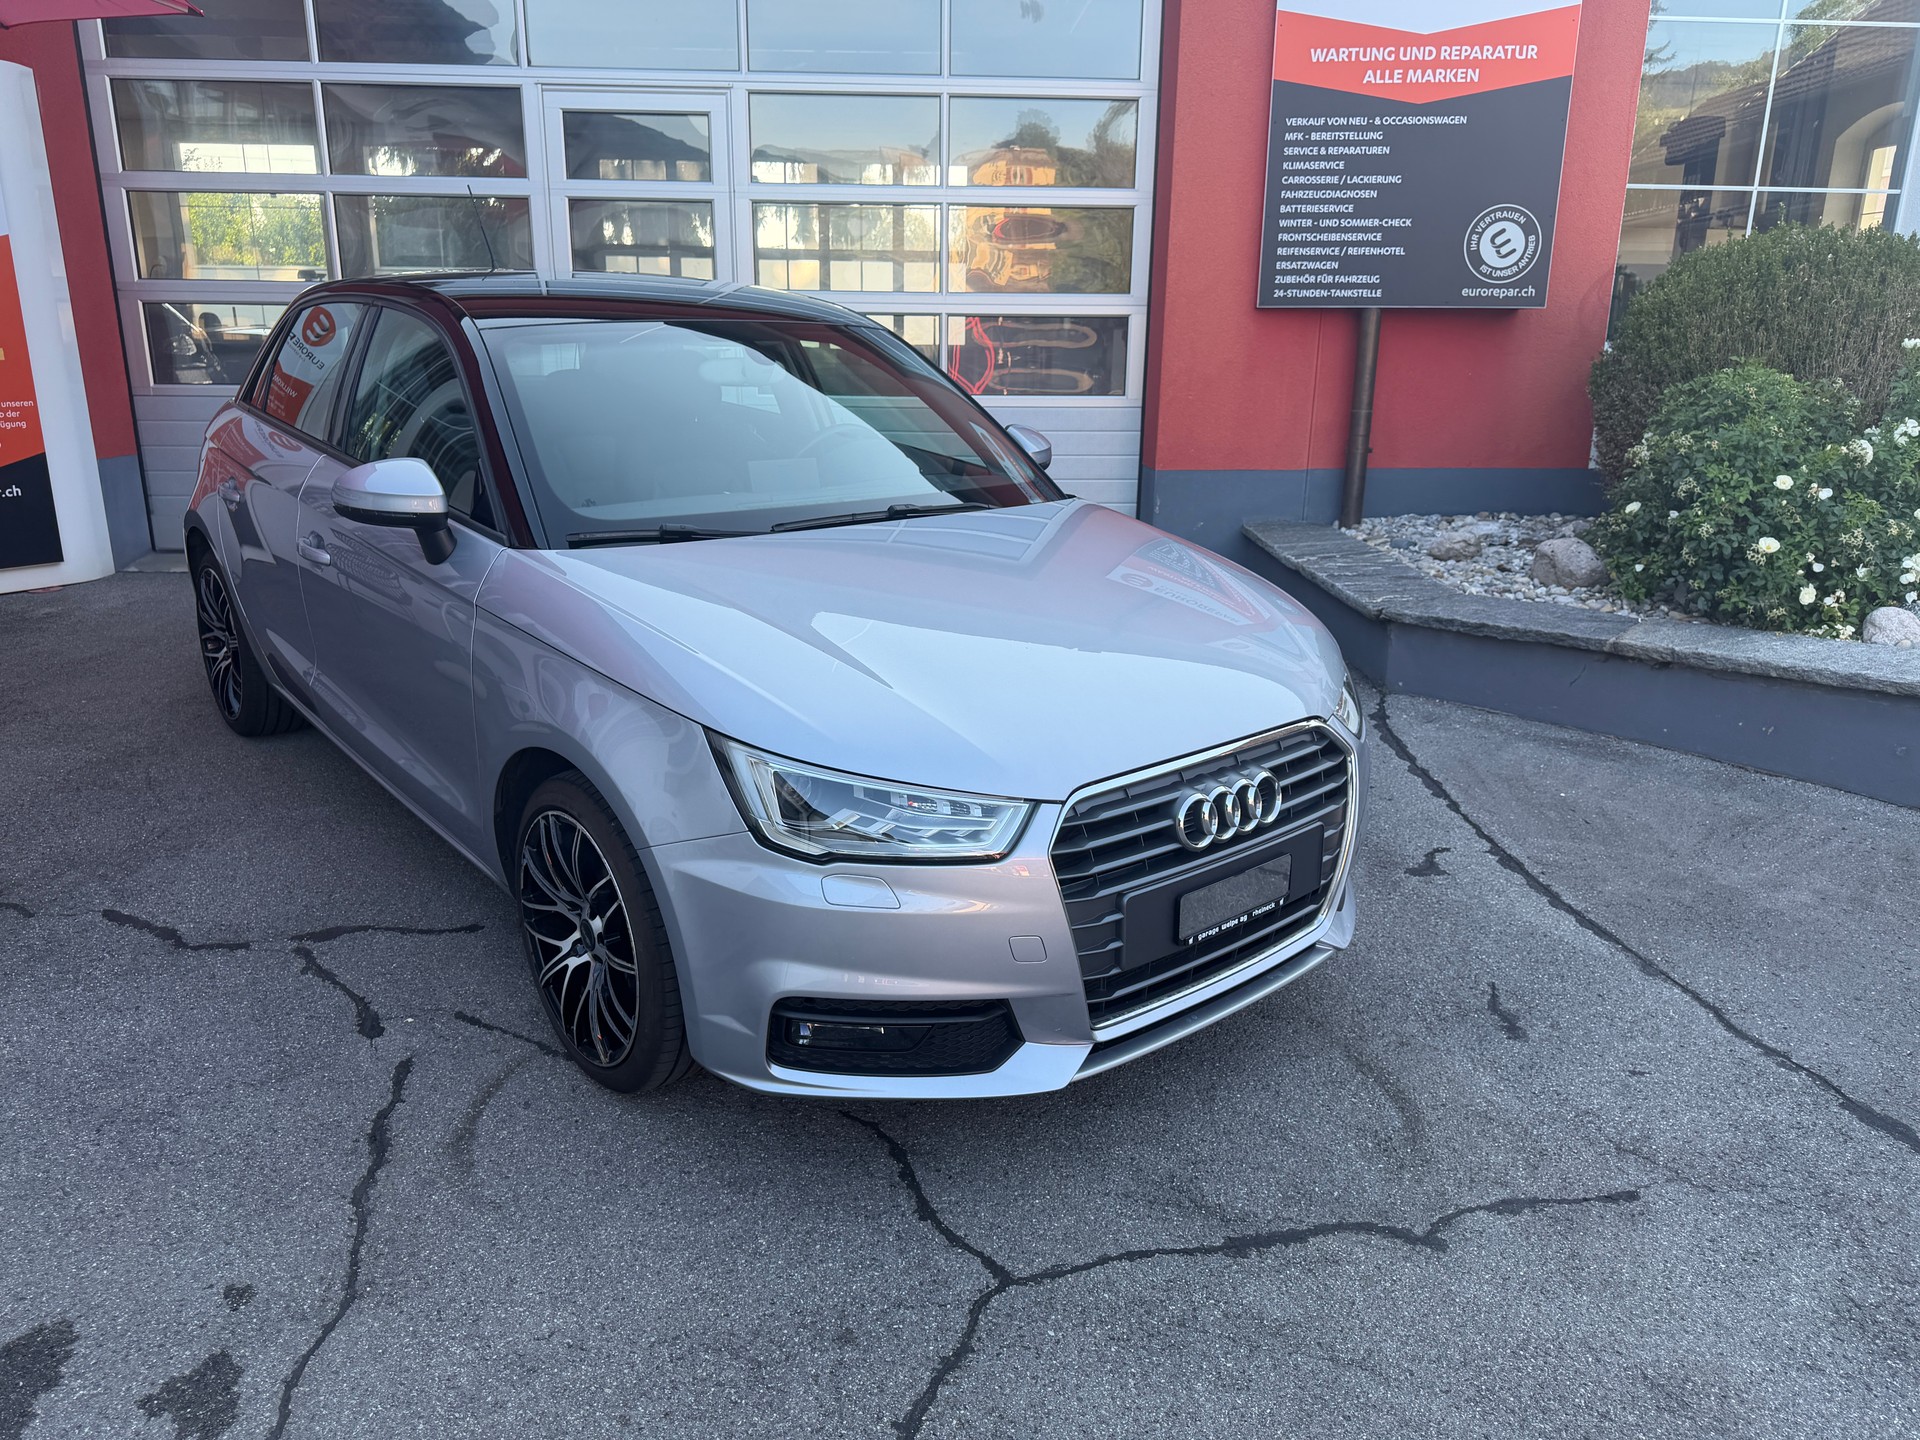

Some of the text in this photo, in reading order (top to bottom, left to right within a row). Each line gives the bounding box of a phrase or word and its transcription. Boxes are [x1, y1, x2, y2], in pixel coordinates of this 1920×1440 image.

[1310, 45, 1538, 62] WARTUNG UND REPARATUR
[1363, 68, 1480, 84] ALLE MARKEN
[1286, 117, 1326, 127] VERKAUF
[1327, 117, 1347, 126] VON
[1349, 117, 1368, 126] NEU
[1374, 117, 1382, 125] &
[1382, 115, 1467, 125] OCCASIONSWAGEN
[1285, 132, 1304, 141] MFK
[1311, 131, 1383, 141] BEREITSTELLUNG
[1283, 146, 1390, 155] SERVICE & REPARATUREN
[1283, 161, 1345, 170] KLIMASERVICE
[1281, 175, 1339, 185] CARROSSERIE
[1347, 175, 1402, 184] LACKIERUNG
[1281, 190, 1378, 199] FAHRZEUGDIAGNOSEN
[1279, 204, 1354, 213] BATTERIESERVICE
[1279, 218, 1313, 227] WINTER
[1319, 218, 1339, 227] UND
[1340, 218, 1412, 227] SOMMER-CHECK
[1470, 210, 1527, 251] IHR VERTRAUEN
[1278, 232, 1383, 242] FRONTSCHEIBENSERVICE
[1276, 246, 1340, 256] REIFENSERVICE
[1347, 246, 1406, 255] REIFENHOTEL
[1480, 234, 1536, 277] IST UNSER ANTRIEB
[1275, 261, 1339, 270] ERSATZWAGEN
[1274, 274, 1380, 284] ZUBEHÖR FÜR FAHRZEUG
[1273, 289, 1383, 298] 24-STUNDEN-TANKSTELLE
[1461, 285, 1536, 299] eurorepar.ch
[0, 400, 34, 408] unseren
[6, 410, 21, 418] der
[0, 485, 22, 498] .ch
[1198, 926, 1220, 941] garage
